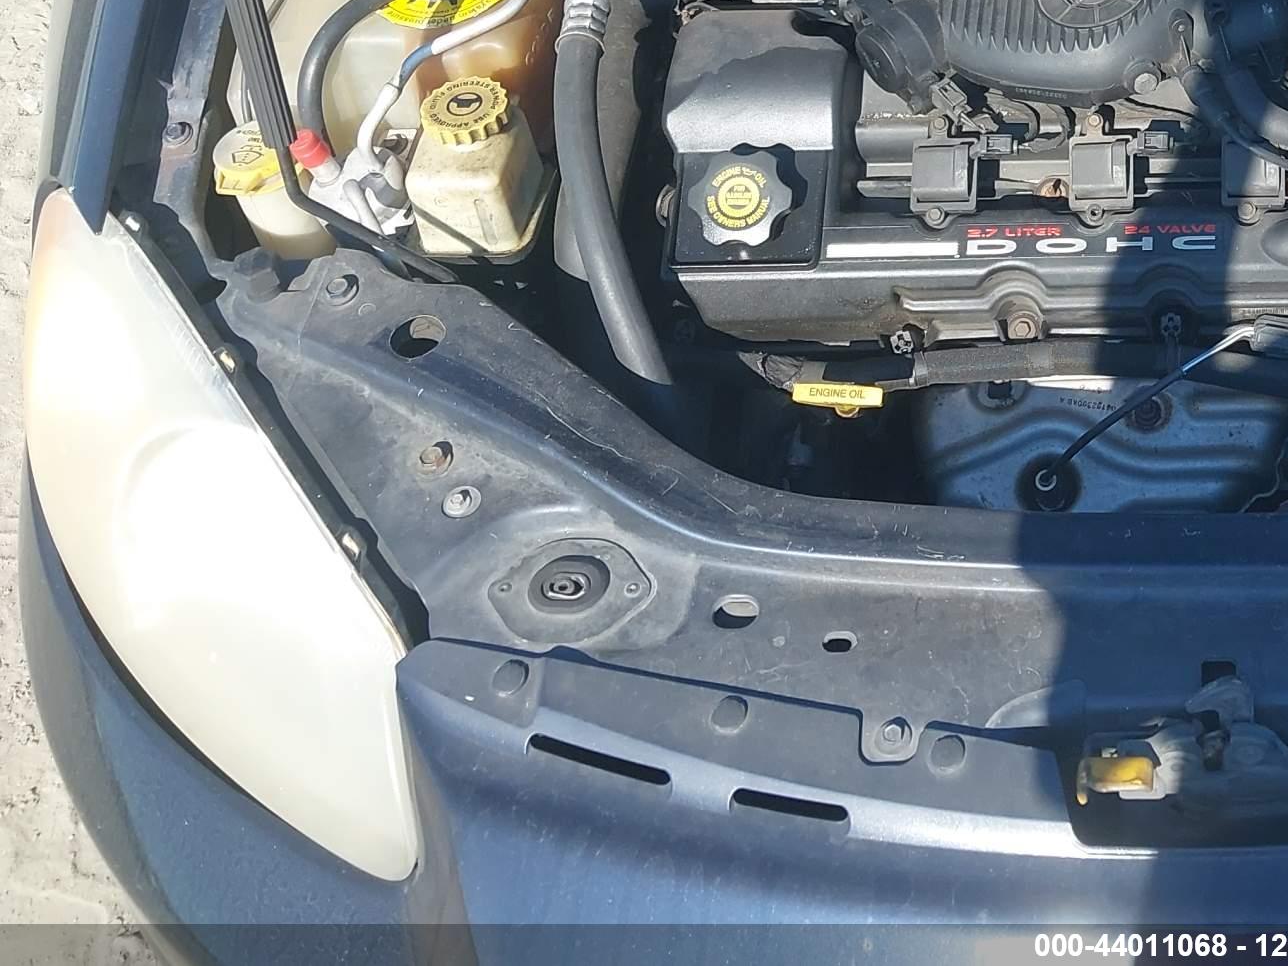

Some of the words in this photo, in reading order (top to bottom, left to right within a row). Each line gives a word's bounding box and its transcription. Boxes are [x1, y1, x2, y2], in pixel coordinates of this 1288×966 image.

[711, 166, 741, 187] ENGINE
[754, 173, 767, 188] OIL
[967, 226, 998, 238] 2.7
[1004, 225, 1063, 237] LITER
[1124, 225, 1152, 235] 24
[1156, 224, 1217, 234] VALVE
[809, 387, 846, 399] ENGINE
[848, 389, 866, 400] OIL
